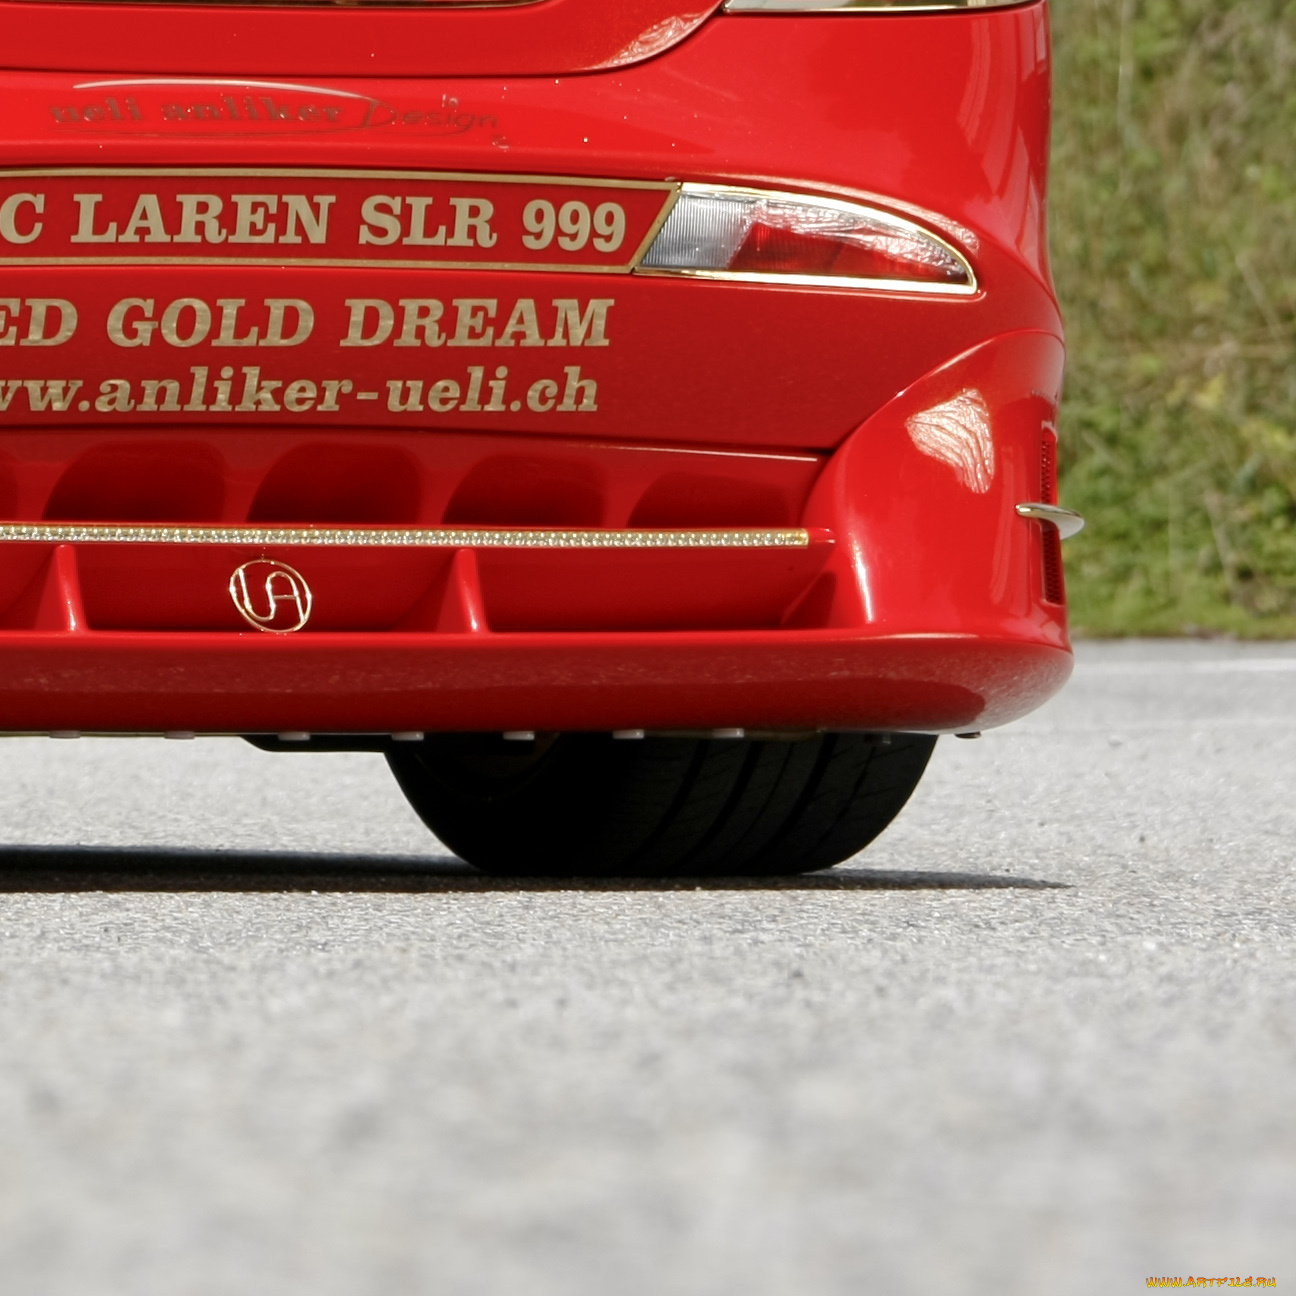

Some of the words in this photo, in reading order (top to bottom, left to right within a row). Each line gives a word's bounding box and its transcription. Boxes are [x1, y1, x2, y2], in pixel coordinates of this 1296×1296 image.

[162, 96, 345, 124] anliker
[69, 192, 336, 245] LAREN
[358, 194, 498, 249] SLR
[521, 198, 627, 254] 999
[106, 296, 316, 348] GOLD
[339, 297, 615, 347] DREAM
